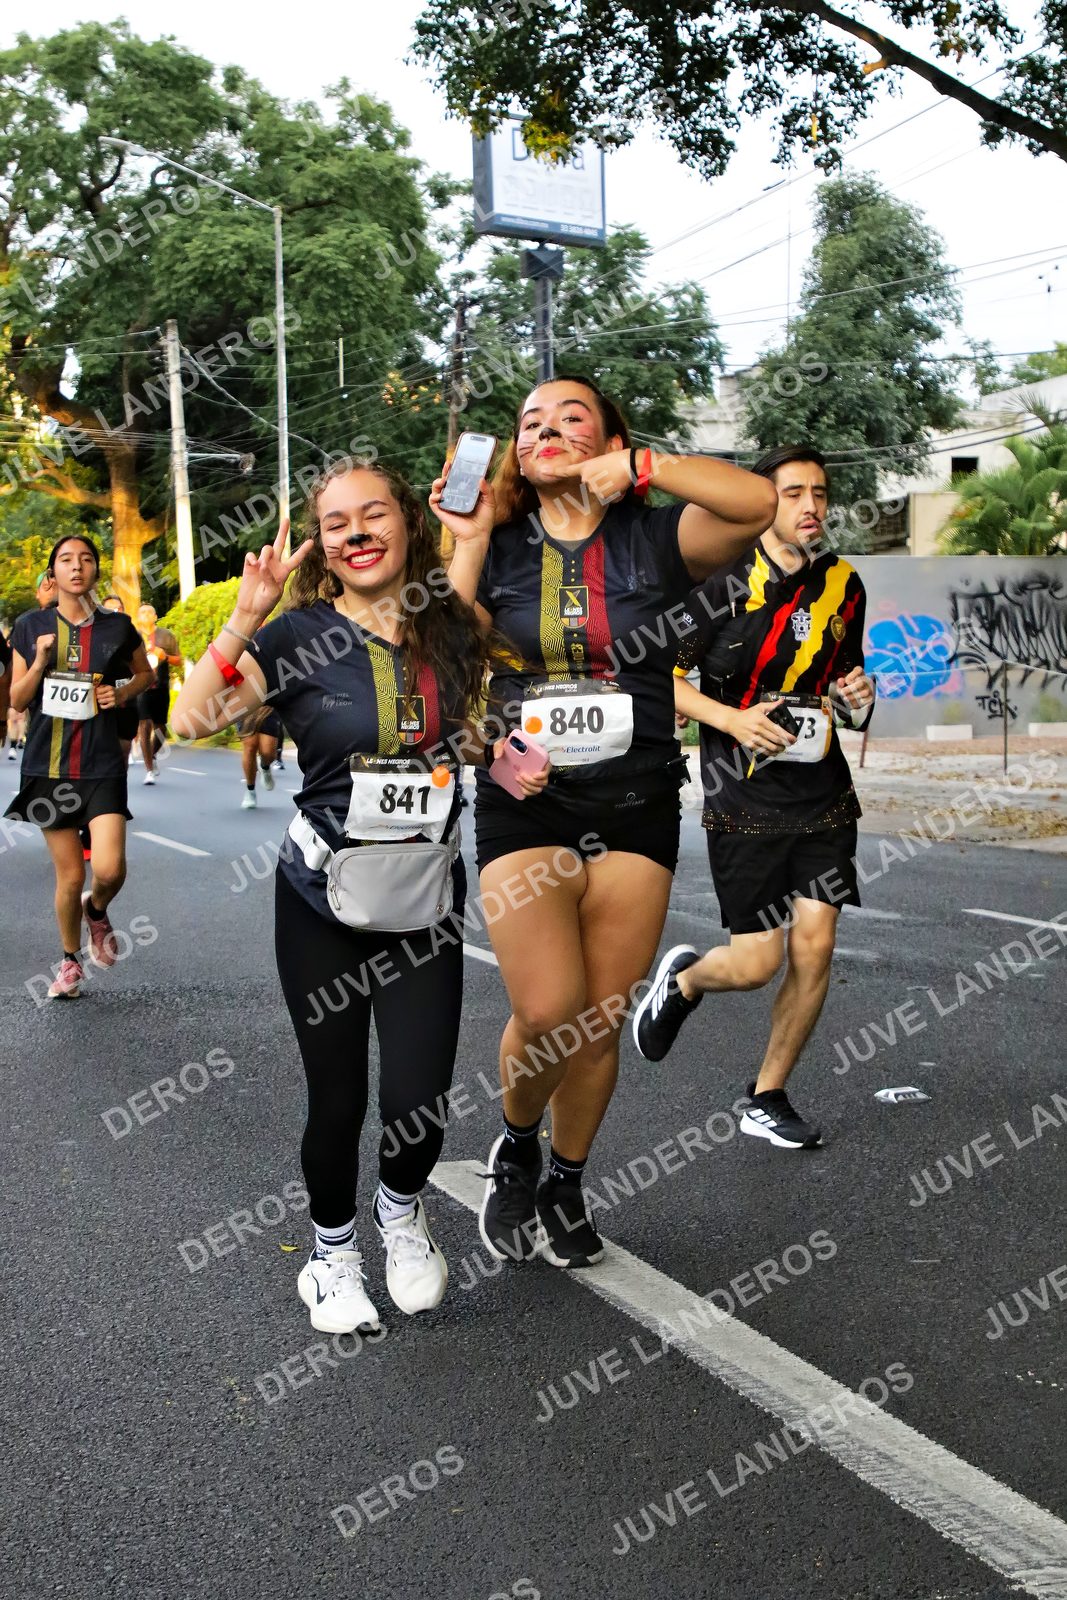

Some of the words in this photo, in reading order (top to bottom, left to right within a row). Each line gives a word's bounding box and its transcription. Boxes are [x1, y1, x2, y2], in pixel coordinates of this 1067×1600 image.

[50, 686, 89, 703] 7067
[550, 706, 604, 735] 840
[566, 745, 600, 754] Electrolit
[379, 784, 431, 814] 841
